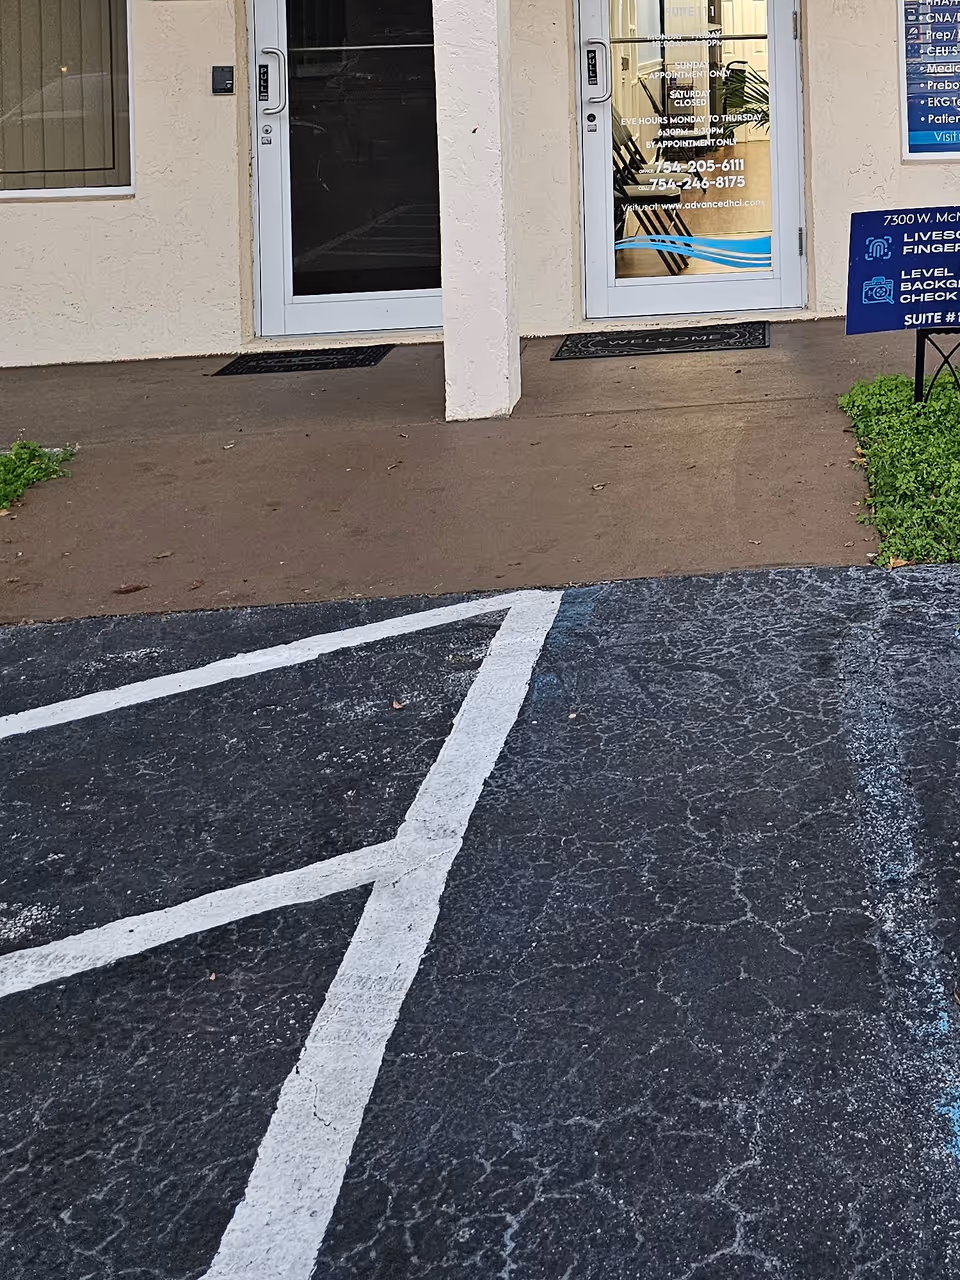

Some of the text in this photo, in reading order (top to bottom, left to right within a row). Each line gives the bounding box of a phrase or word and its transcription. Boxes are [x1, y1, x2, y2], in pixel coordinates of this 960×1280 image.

[926, 45, 958, 56] CEU'S
[588, 53, 596, 77] PULL
[674, 61, 710, 70] SUNDAY
[709, 70, 732, 78] ONLY
[669, 89, 711, 99] SATURDAY
[674, 99, 706, 107] CLOSED
[927, 96, 951, 107] EKG
[621, 113, 762, 126] EVE HOURS MONDAY TO THURSDAY
[934, 131, 957, 142] Visit
[645, 138, 738, 149] BY APPOINTMENT ONLY
[655, 158, 745, 174] 754-205-6111
[649, 175, 746, 191] 754-246-8175
[883, 214, 915, 226] 7300
[901, 268, 955, 279] LEVEL
[899, 291, 958, 304] CHECK
[904, 311, 942, 326] SUITE
[608, 333, 722, 345] WELCOME
